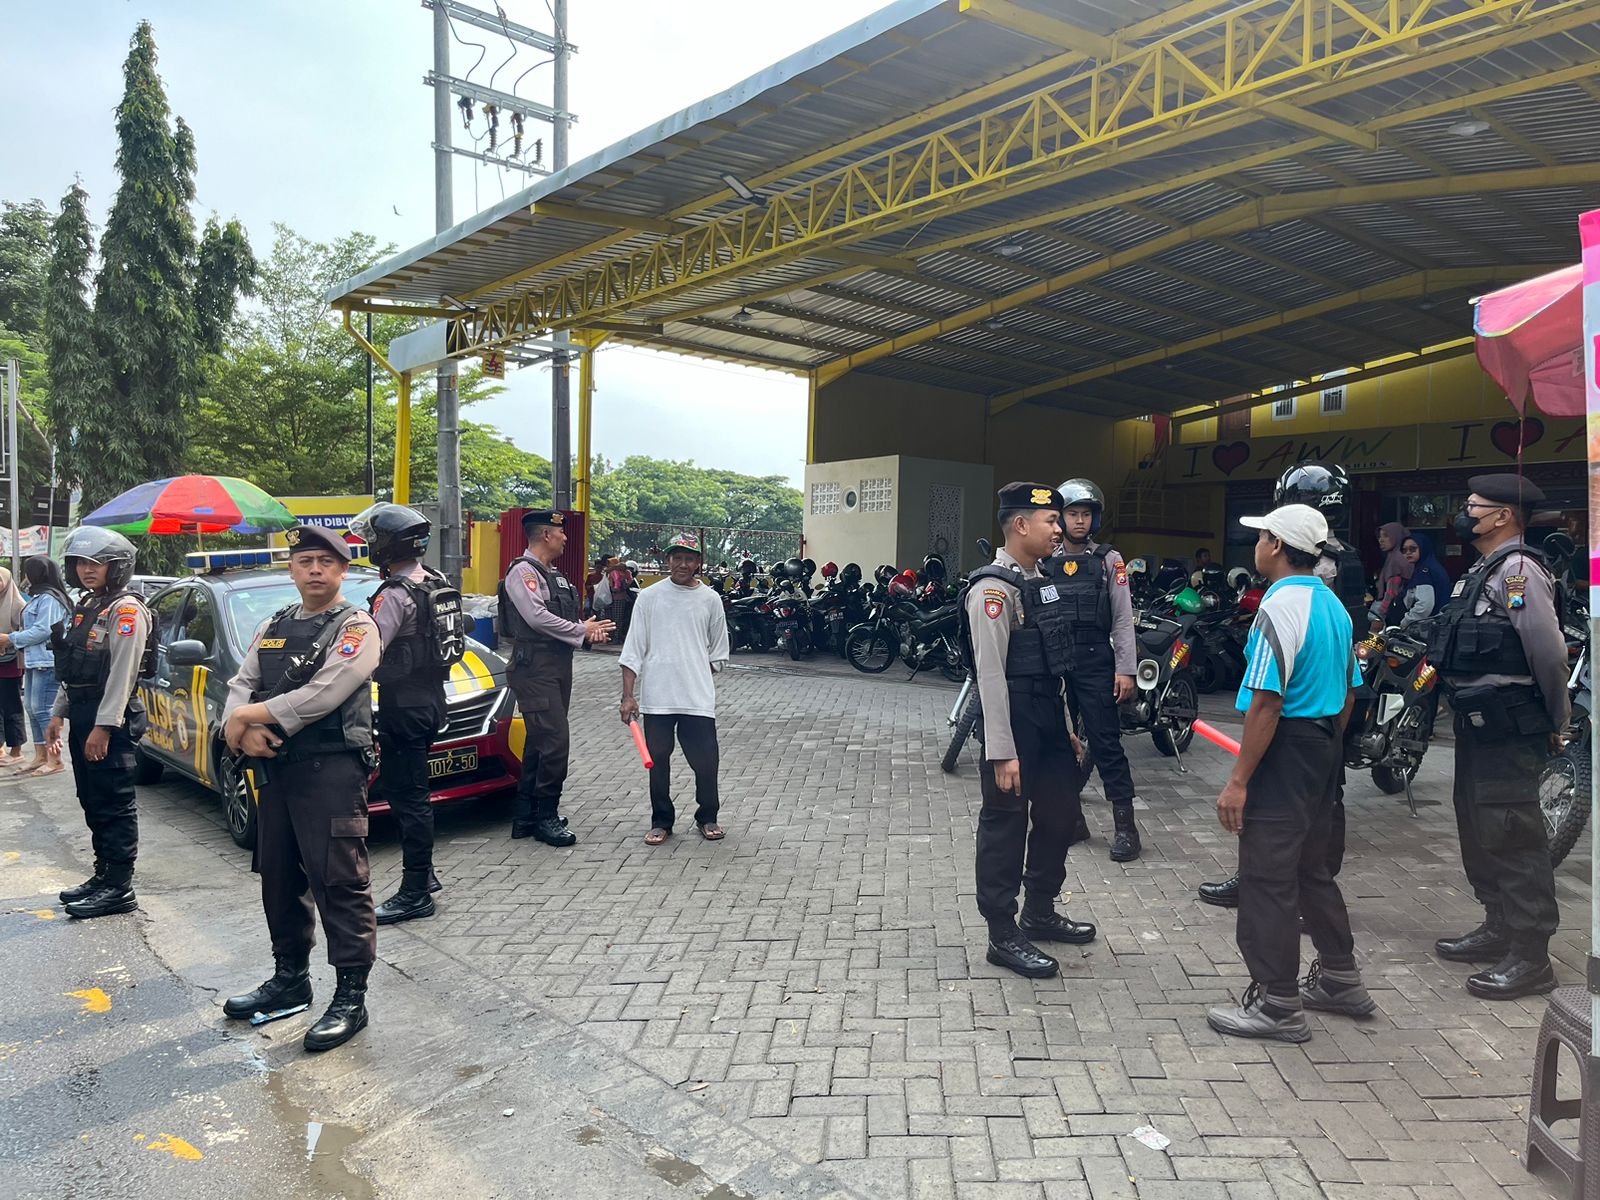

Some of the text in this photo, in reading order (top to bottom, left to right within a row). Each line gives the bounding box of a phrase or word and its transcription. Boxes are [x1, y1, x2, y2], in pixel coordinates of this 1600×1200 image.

[1182, 445, 1209, 478] I
[1344, 461, 1388, 470] SHION
[298, 516, 352, 527] LAH DIBU
[1168, 643, 1189, 669] RAIMAS
[137, 686, 174, 732] LISI
